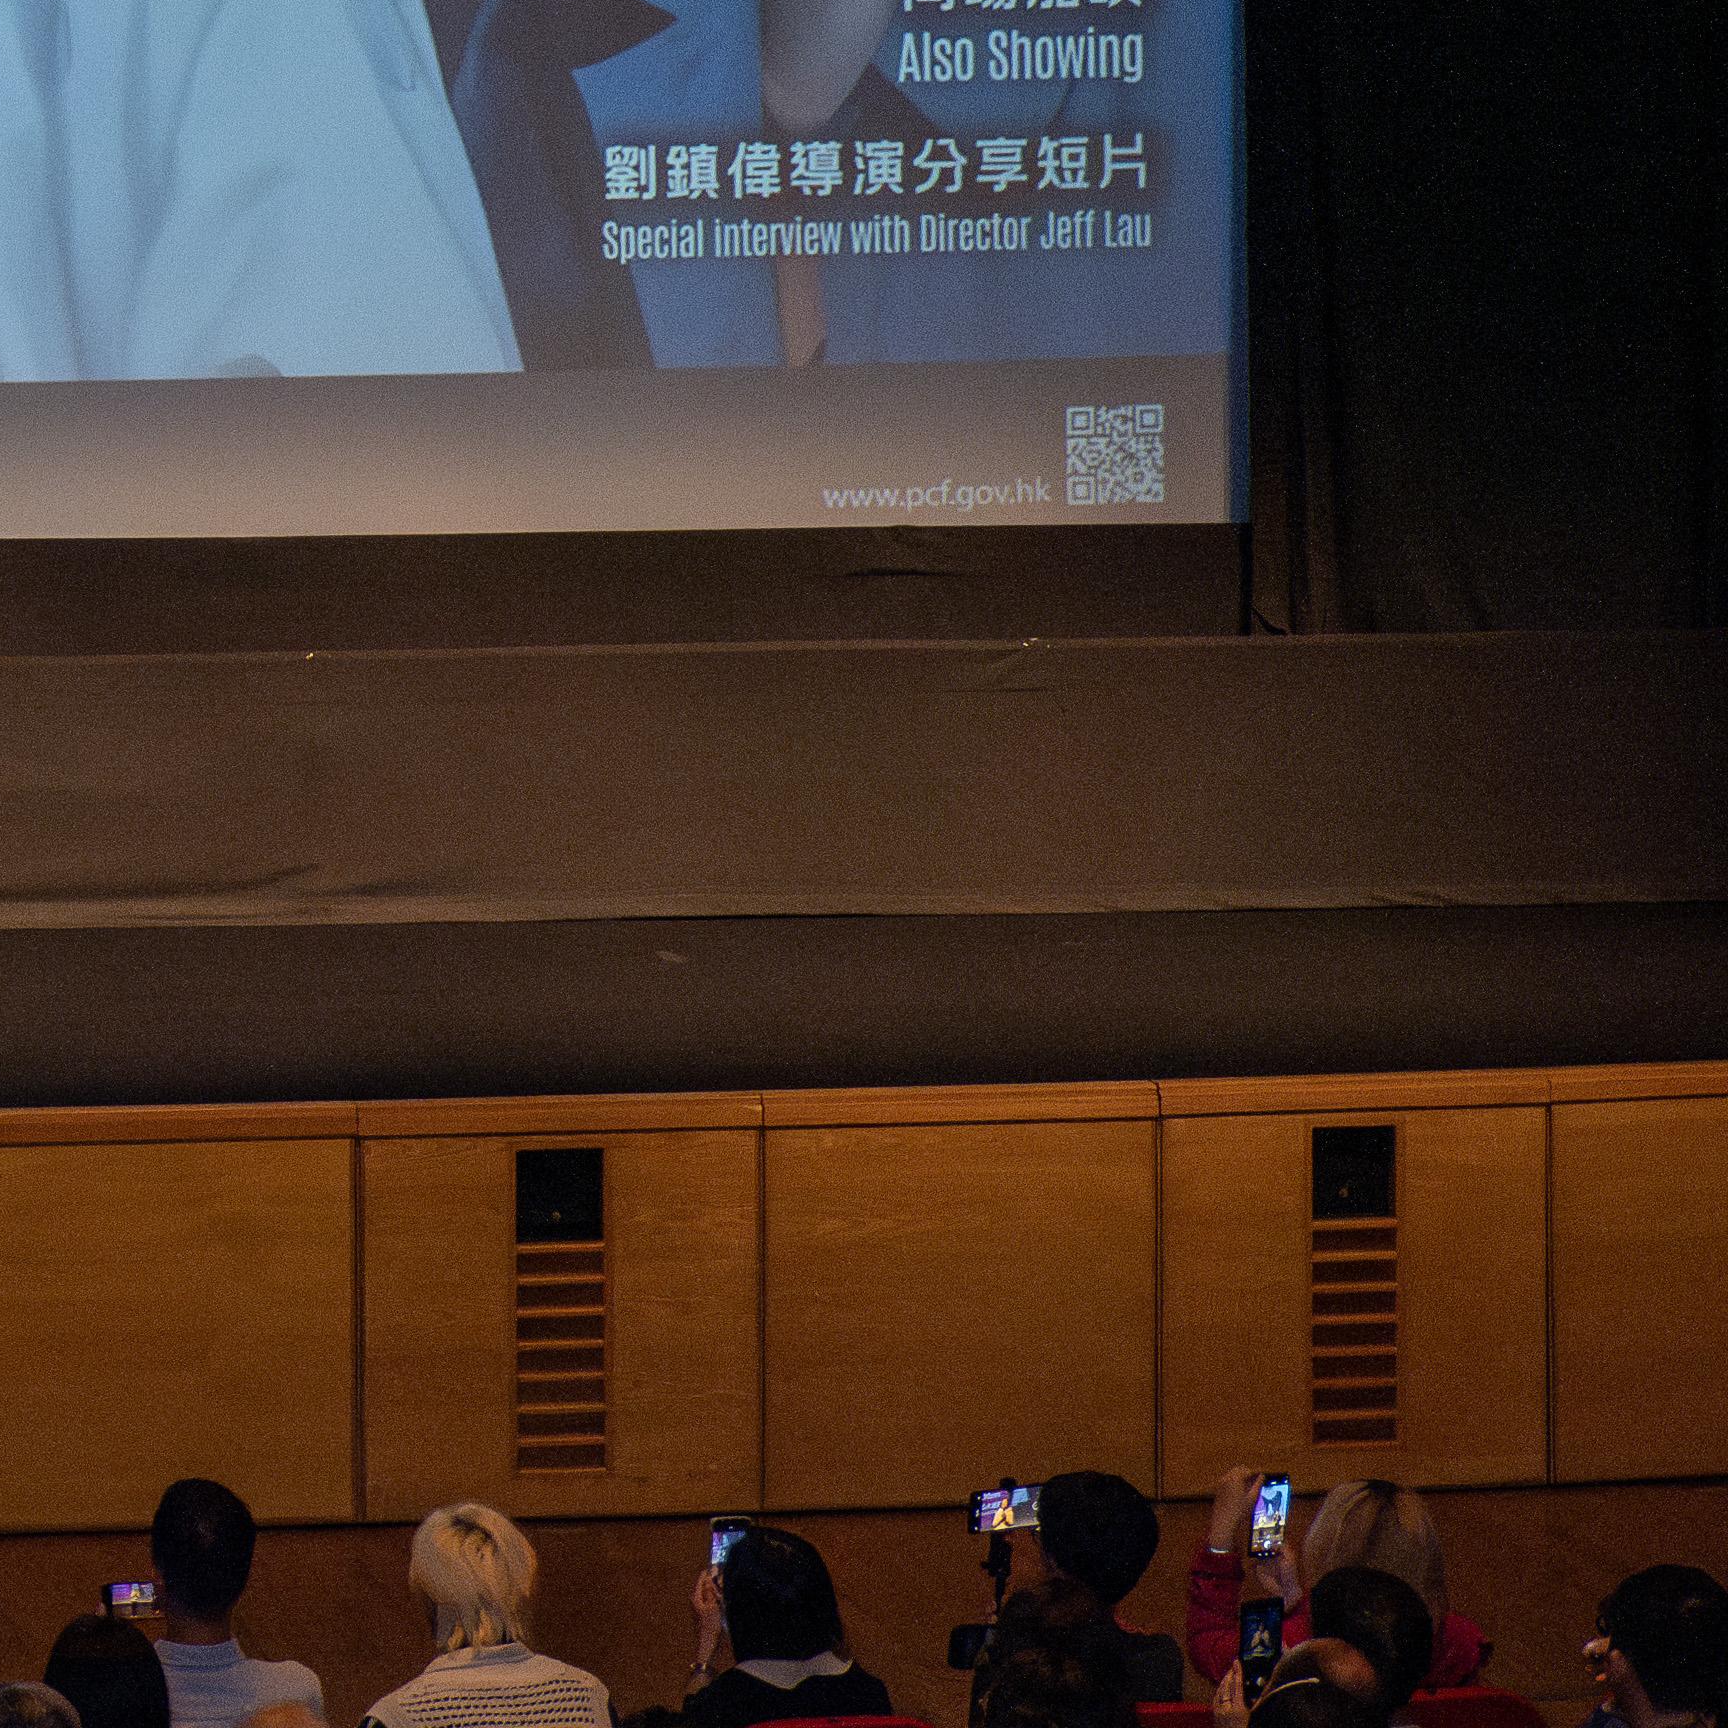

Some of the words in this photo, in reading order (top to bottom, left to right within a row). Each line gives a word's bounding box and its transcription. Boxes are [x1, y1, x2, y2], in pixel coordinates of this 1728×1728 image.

[898, 32, 973, 84] Also
[988, 27, 1143, 84] Showing
[605, 133, 1148, 201] 劉鎮偉導演分享短片
[602, 218, 704, 264] Special
[714, 215, 843, 257] interview
[850, 214, 910, 254] with
[920, 211, 1032, 252] Director
[1040, 209, 1095, 251] Jeff
[1104, 208, 1151, 248] Lau
[823, 476, 1051, 512] www.pcf.gov.hk
